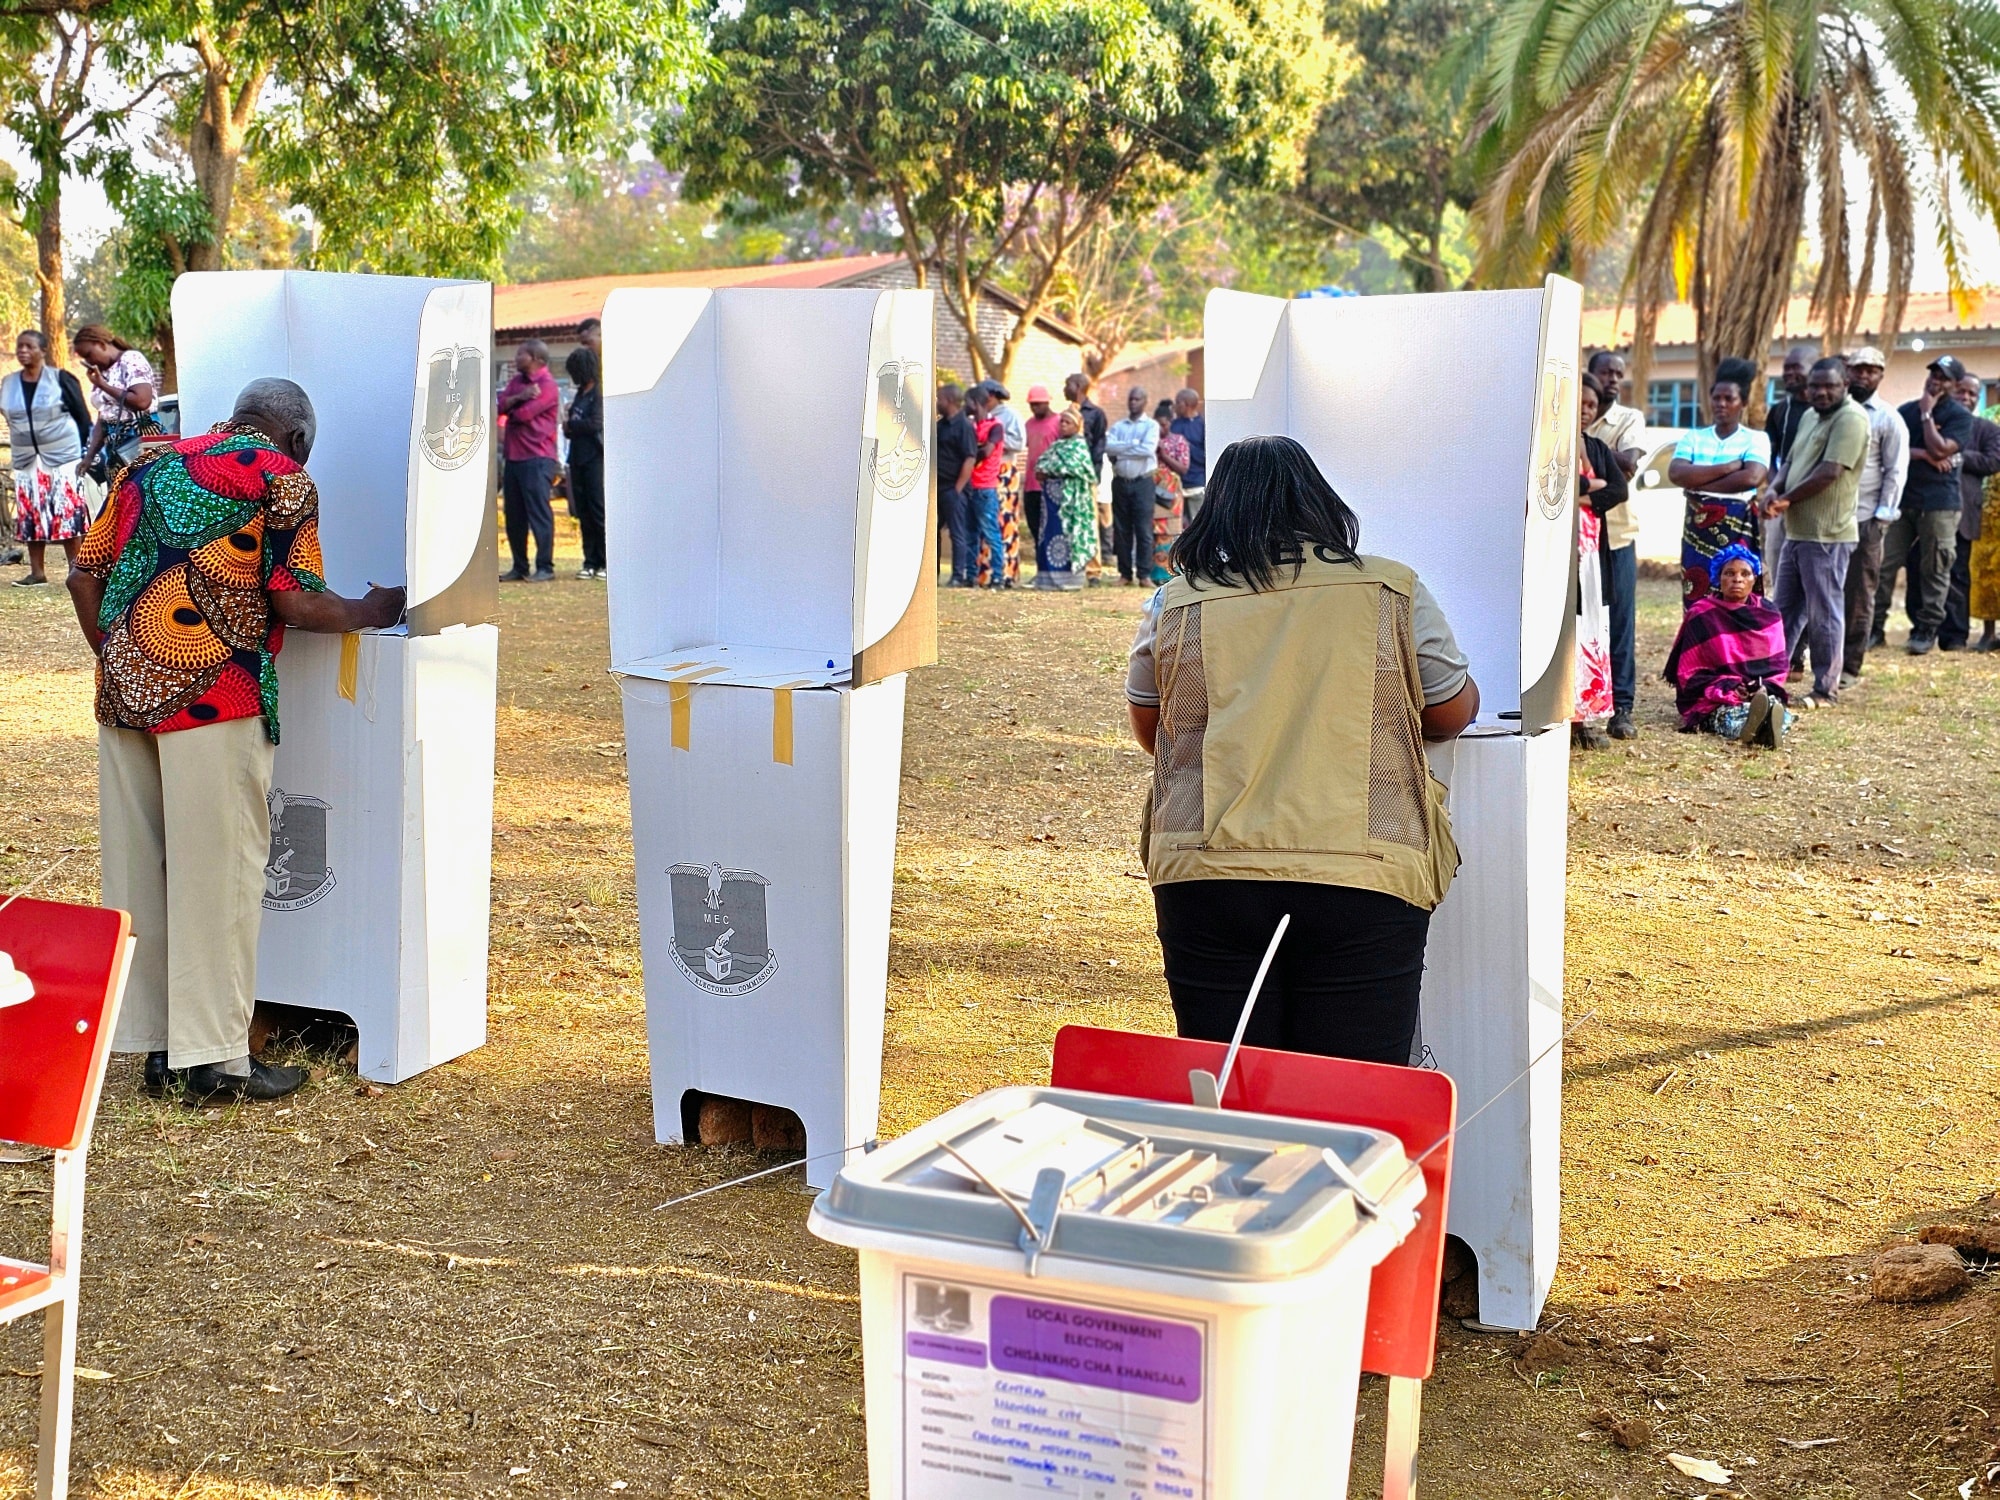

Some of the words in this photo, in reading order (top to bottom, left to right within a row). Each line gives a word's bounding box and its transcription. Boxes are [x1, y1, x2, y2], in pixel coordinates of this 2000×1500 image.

[270, 836, 290, 846] EC
[295, 881, 332, 907] COMMISSION
[703, 913, 731, 925] MEC
[671, 949, 692, 978] MALAWI
[694, 977, 733, 994] ELECTORAL
[738, 964, 775, 993] COMMISSION
[1025, 1306, 1068, 1325] LOCAL
[1072, 1314, 1164, 1340] GOVERNMENT
[1063, 1332, 1124, 1353] ELECTION
[1003, 1345, 1080, 1369] CHISANKHO
[1083, 1359, 1113, 1376] CHA
[1116, 1365, 1186, 1387] KHANSALA
